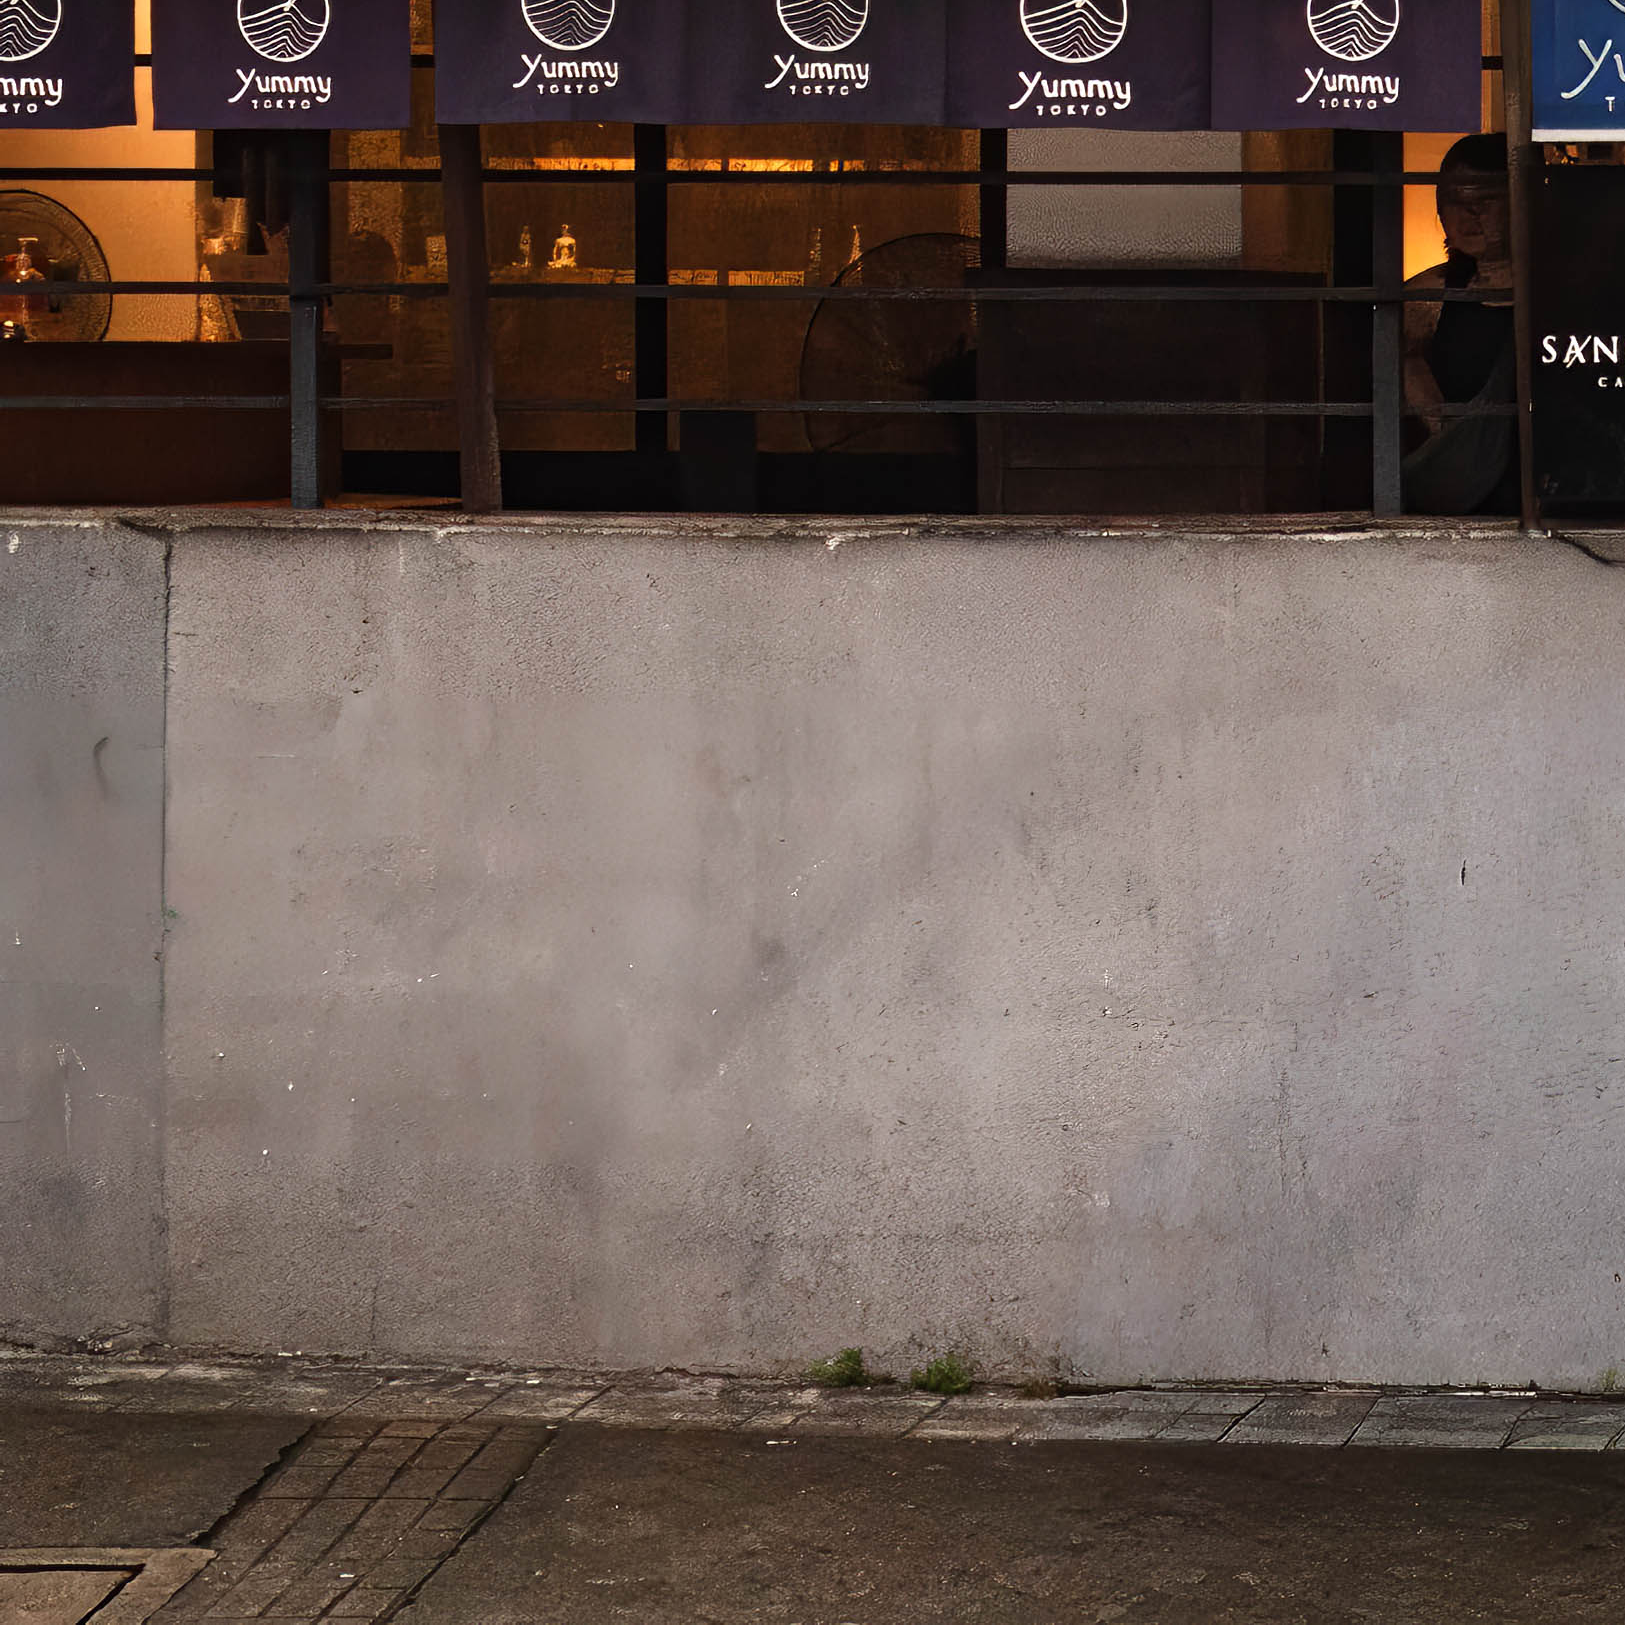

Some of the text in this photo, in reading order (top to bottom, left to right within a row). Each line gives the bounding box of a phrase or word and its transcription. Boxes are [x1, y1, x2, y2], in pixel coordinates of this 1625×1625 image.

[513, 54, 618, 94] Yummy
[765, 54, 869, 89] Yummy
[0, 77, 62, 106] mmy
[228, 68, 331, 103] Yummy
[538, 84, 599, 95] TOKYO
[789, 85, 849, 96] TOKYO
[1009, 72, 1131, 110] Yummy
[1297, 68, 1399, 104] Yummy
[0, 103, 38, 113] KYO
[252, 99, 310, 110] TOKYO
[1036, 104, 1106, 117] TOKYO
[1318, 99, 1377, 110] TOKYO
